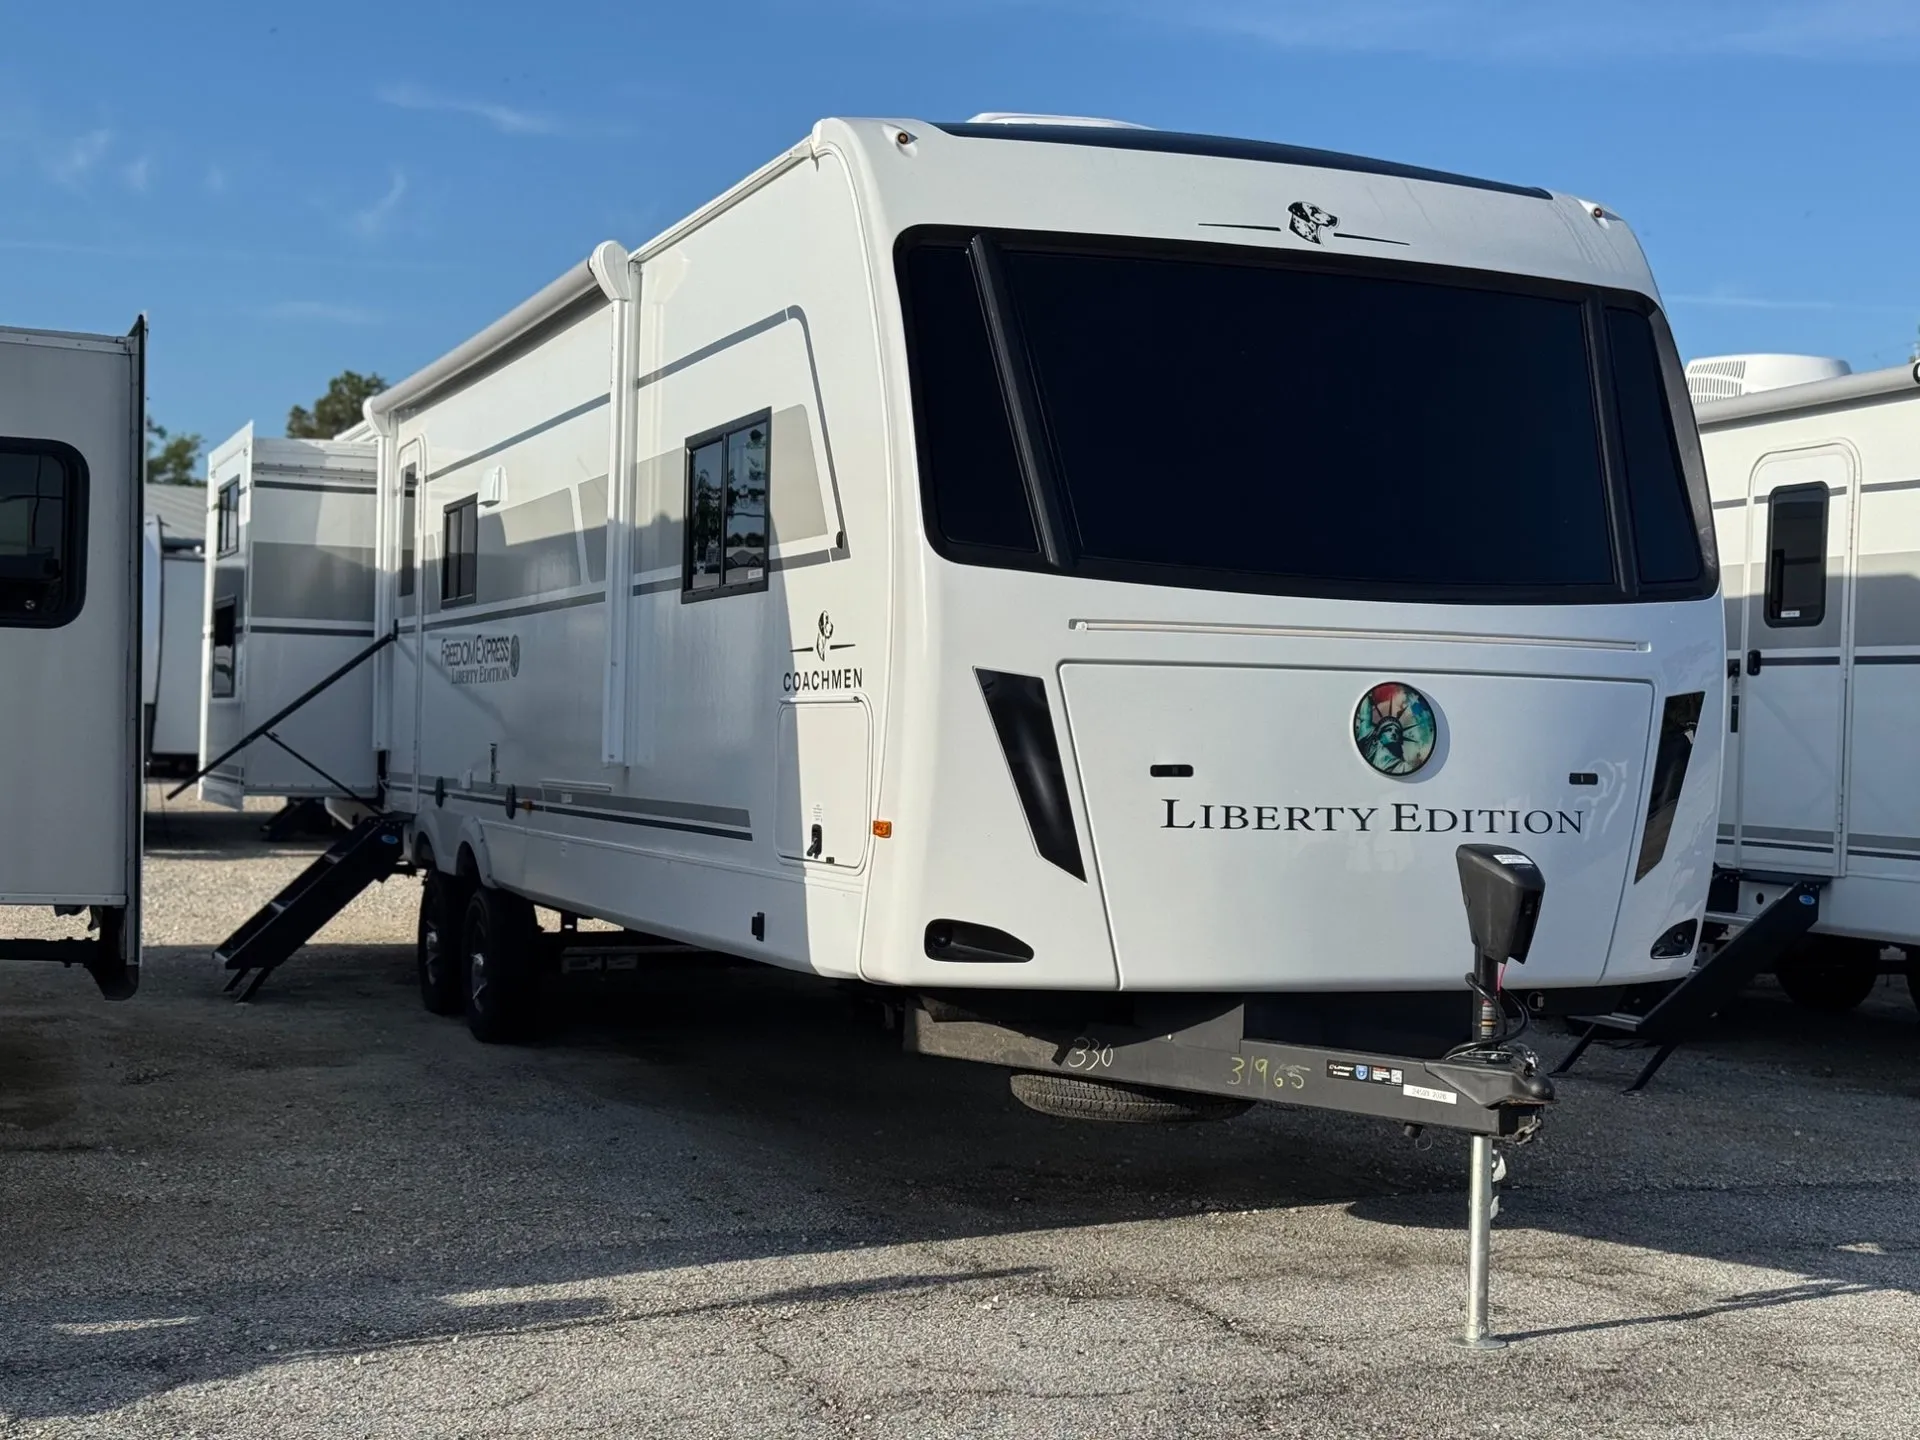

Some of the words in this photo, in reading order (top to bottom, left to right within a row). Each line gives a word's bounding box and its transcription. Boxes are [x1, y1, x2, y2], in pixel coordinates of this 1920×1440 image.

[783, 667, 863, 692] COACHMEN
[1160, 798, 1379, 832] LIBERTY
[1389, 802, 1585, 835] EDITION
[1067, 1036, 1114, 1071] 330
[1226, 1055, 1311, 1096] 31965
